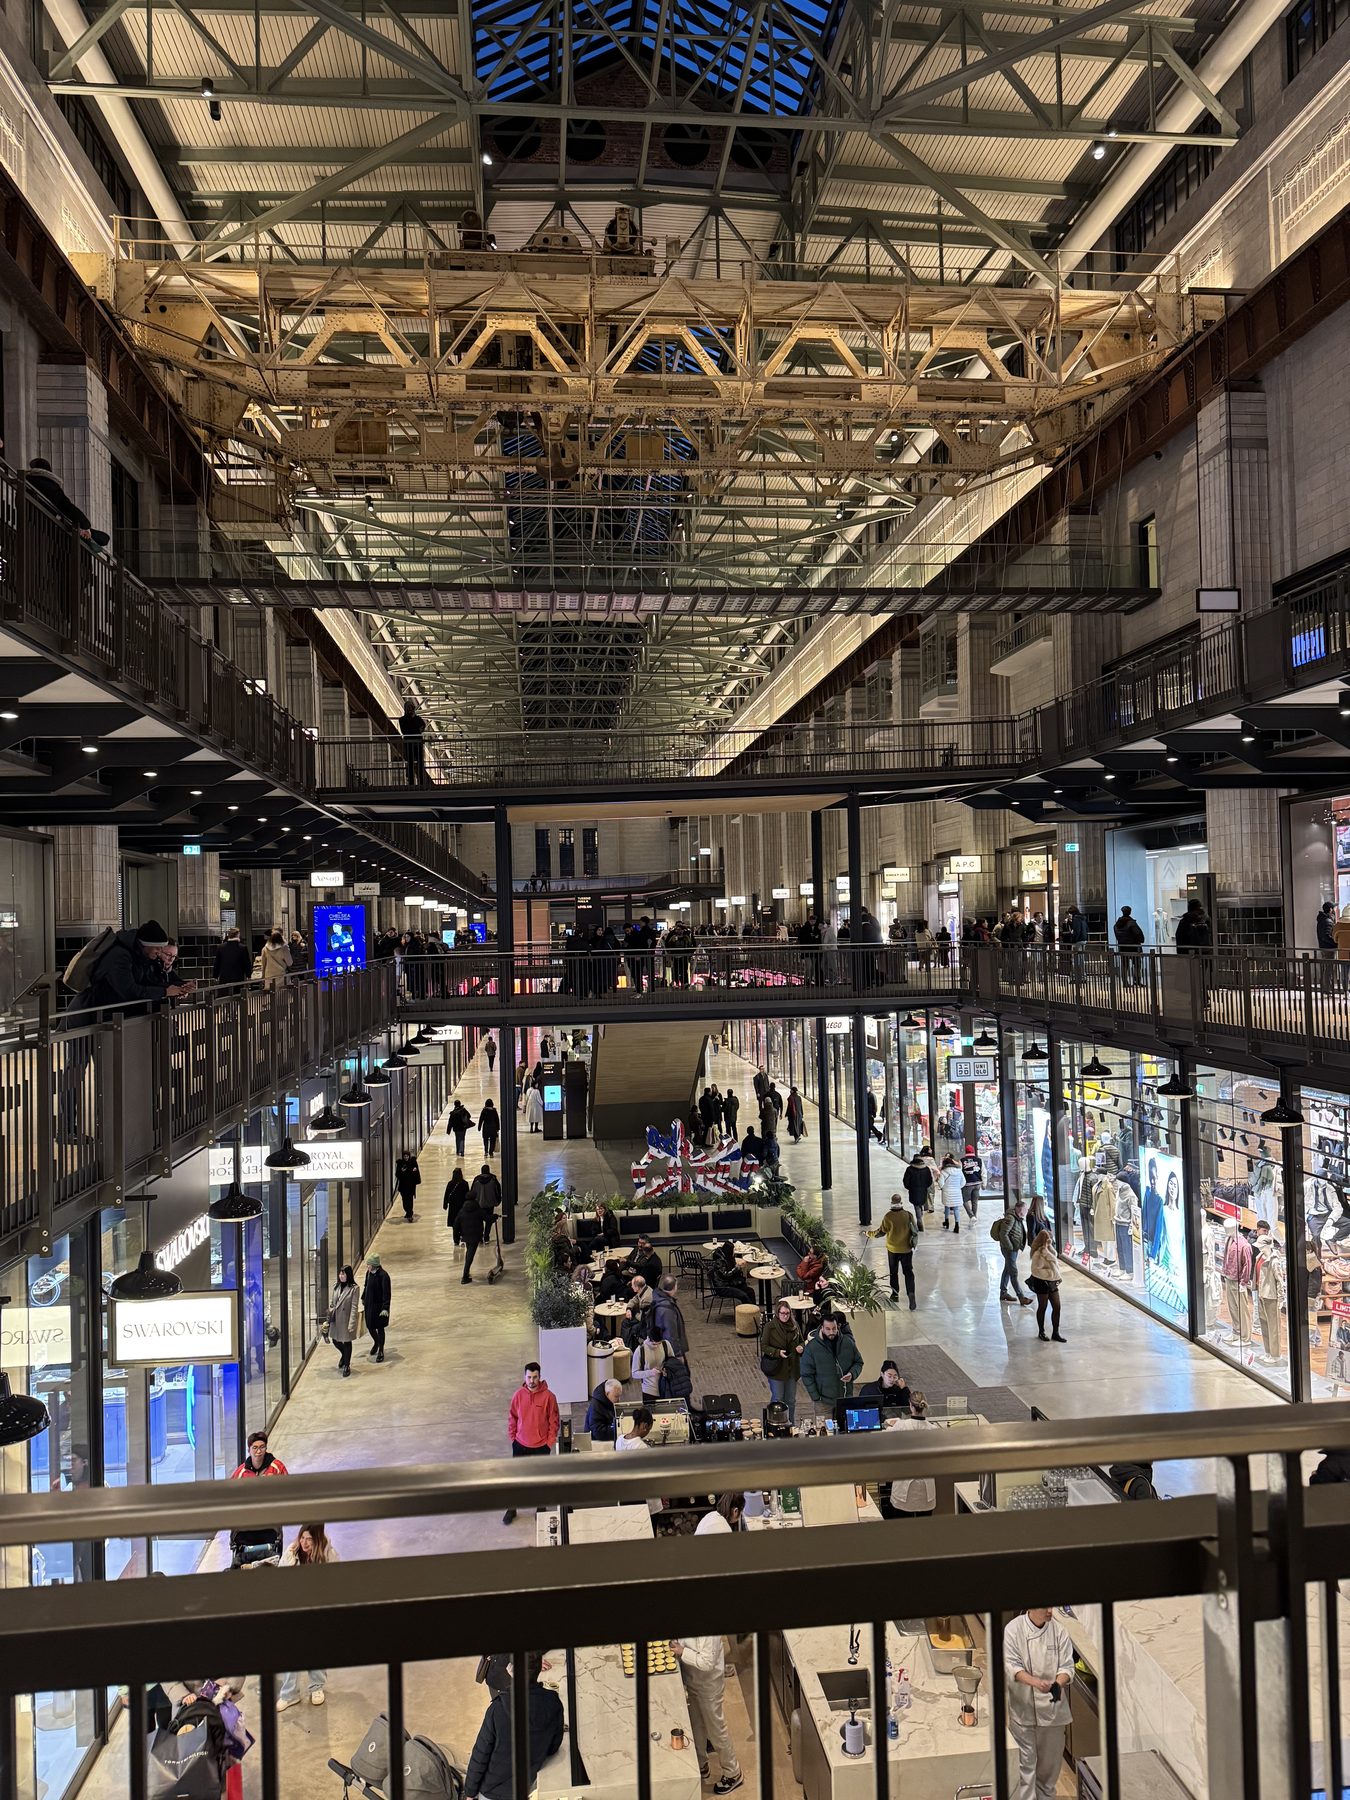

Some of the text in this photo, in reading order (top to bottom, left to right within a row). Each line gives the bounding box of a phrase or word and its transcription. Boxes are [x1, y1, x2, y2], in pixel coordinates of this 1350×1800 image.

[826, 1021, 843, 1029] LEGO
[310, 1151, 344, 1160] ROYAL
[156, 1213, 210, 1271] SWAROVSKI
[123, 1319, 223, 1339] SWAROVSKI
